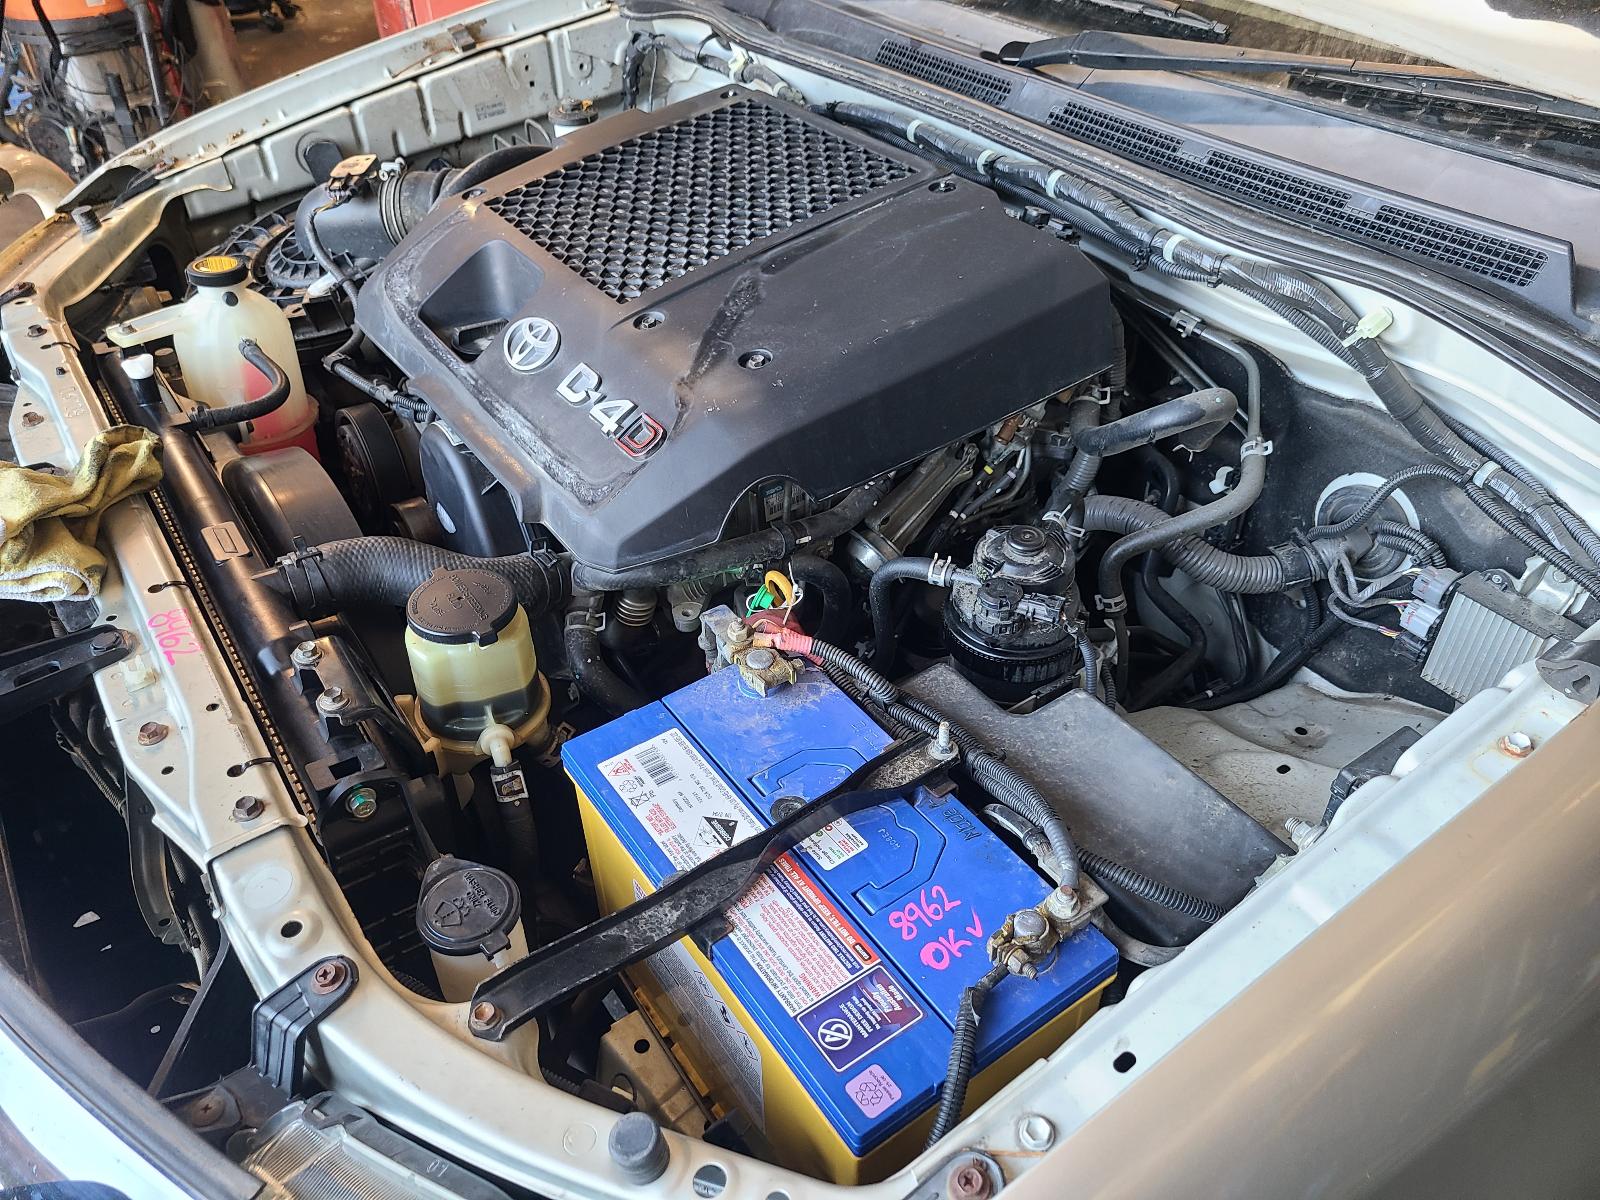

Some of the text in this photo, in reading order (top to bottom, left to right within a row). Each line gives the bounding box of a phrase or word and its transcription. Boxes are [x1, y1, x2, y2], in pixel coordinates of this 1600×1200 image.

[888, 885, 962, 941] 8962
[920, 928, 972, 970] OK
[798, 972, 822, 998] WARNING
